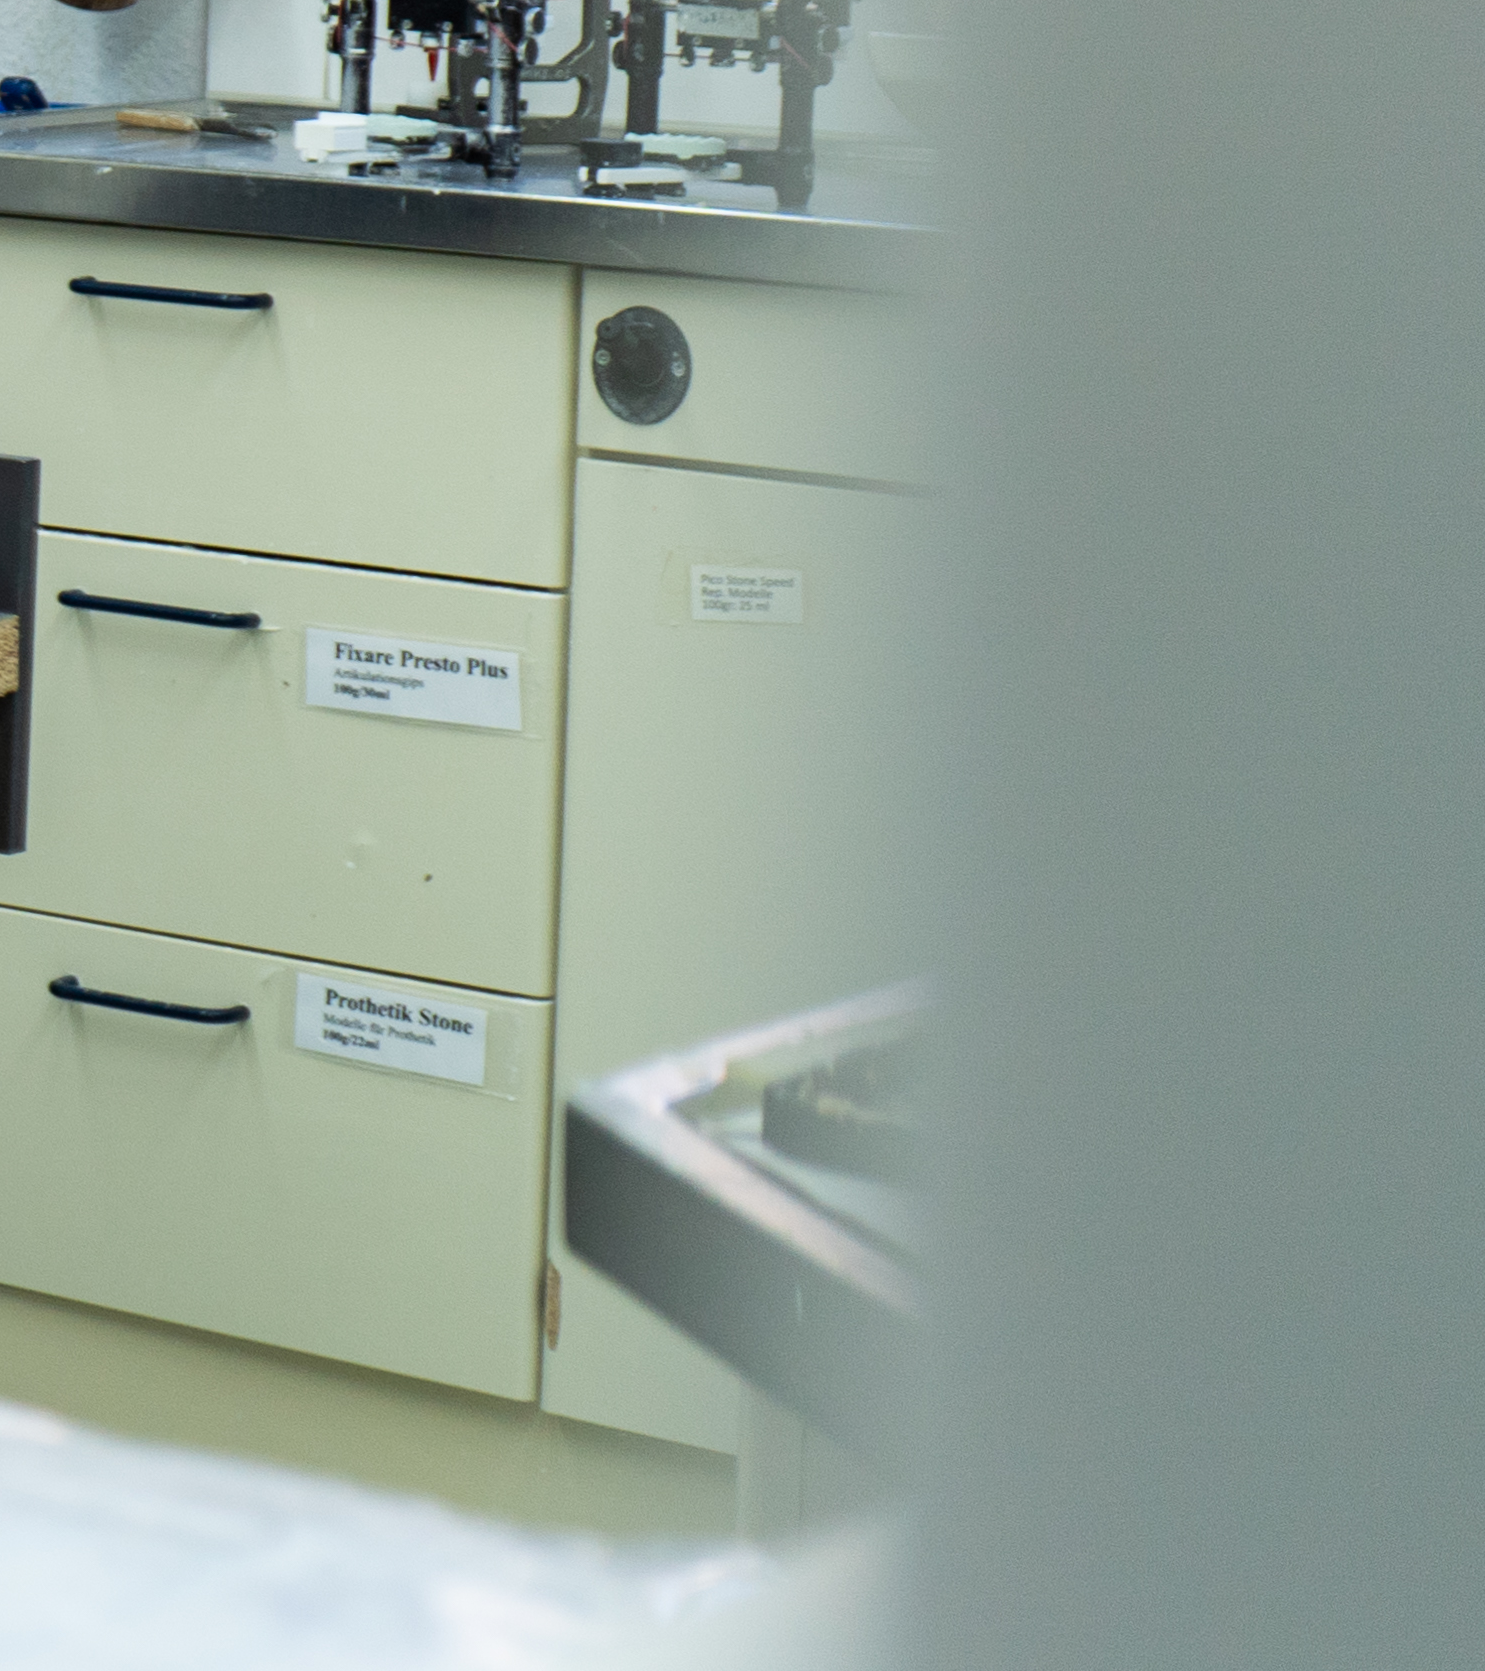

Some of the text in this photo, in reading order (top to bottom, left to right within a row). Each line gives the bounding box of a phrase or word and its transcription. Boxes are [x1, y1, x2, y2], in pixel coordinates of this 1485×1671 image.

[333, 640, 509, 679] Fixare Presto Plus
[324, 987, 475, 1036] Prothetik Stone
[387, 1025, 437, 1047] Prothetik
